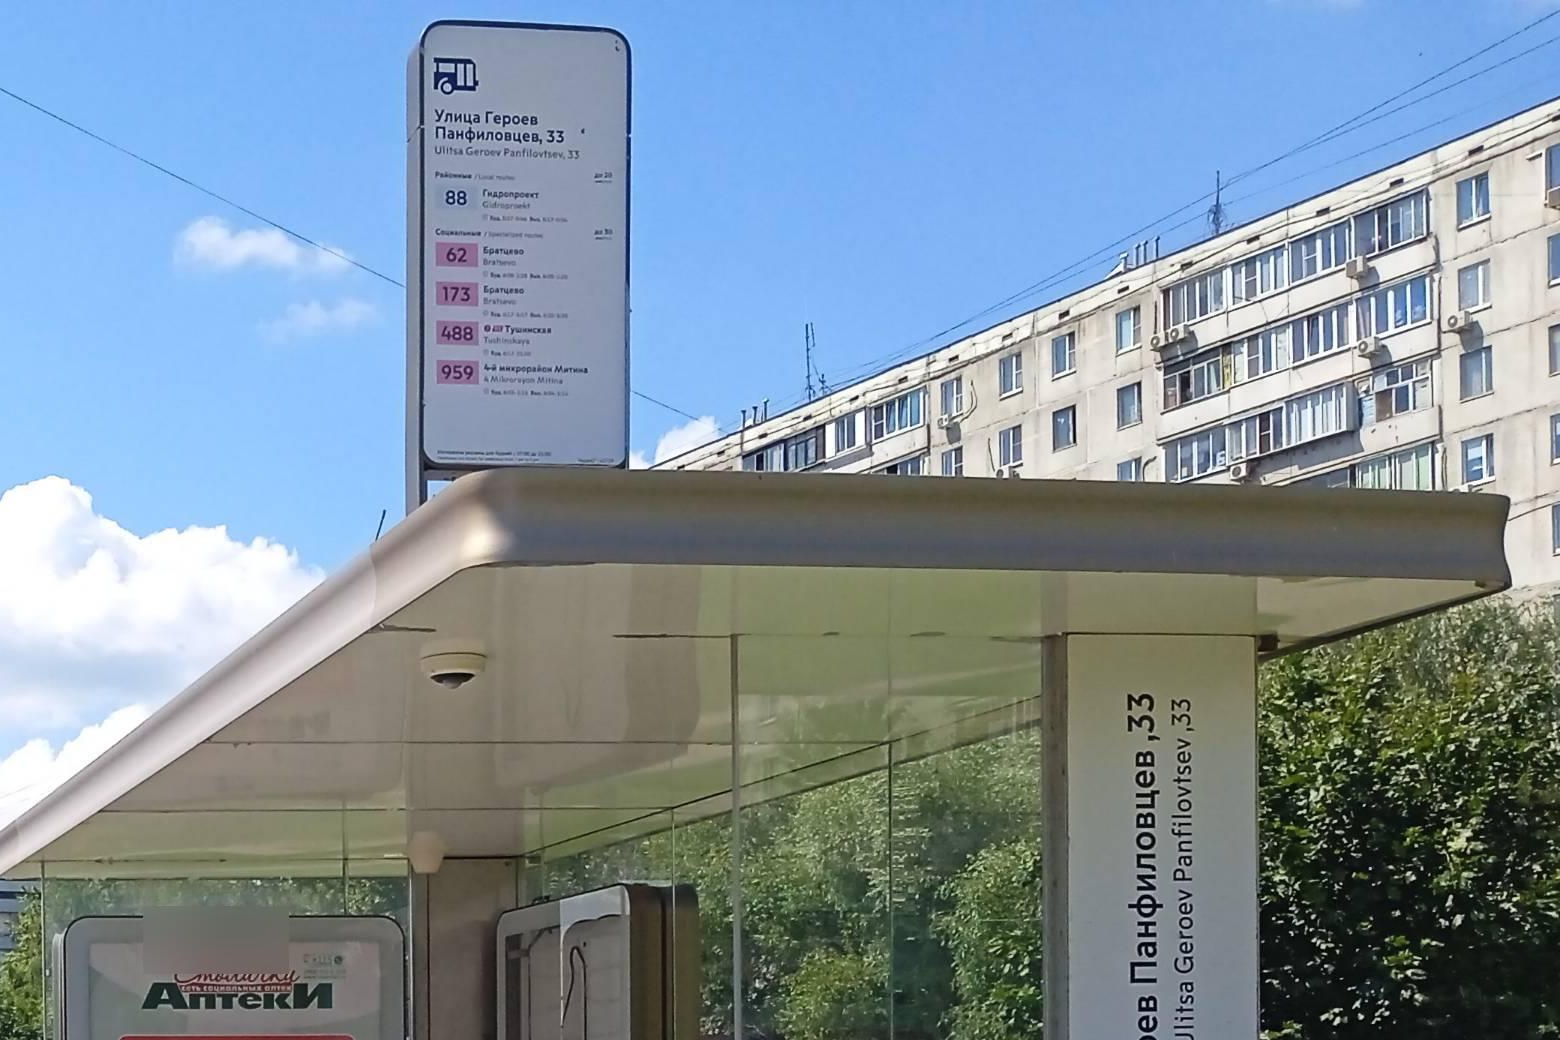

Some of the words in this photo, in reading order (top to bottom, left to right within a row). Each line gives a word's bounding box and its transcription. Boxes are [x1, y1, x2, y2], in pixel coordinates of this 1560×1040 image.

[434, 109, 481, 124] Улица
[485, 111, 538, 128] Героев
[434, 126, 543, 145] Панфиловцев,
[546, 130, 565, 143] 33
[434, 146, 464, 156] Ulitsa
[465, 148, 501, 158] Geroev
[503, 149, 566, 160] Panfilovtsev,
[567, 150, 580, 160] 33
[445, 190, 468, 206] 88
[482, 189, 540, 200] Гидропроект
[435, 228, 482, 238] Социальные
[446, 247, 467, 263] 62
[483, 246, 525, 256] Братцево
[442, 286, 471, 302] 173
[483, 285, 525, 295] Братцево
[441, 326, 473, 341] 488
[505, 325, 552, 335] Тушинская
[441, 365, 474, 380] 959
[499, 364, 553, 375] микрорайон
[554, 365, 589, 374] Митина
[1171, 738, 1194, 882] Panfilovtsev
[1128, 750, 1164, 984] Панфиловцев
[1173, 891, 1195, 973] Geroev
[203, 985, 262, 993] социальных
